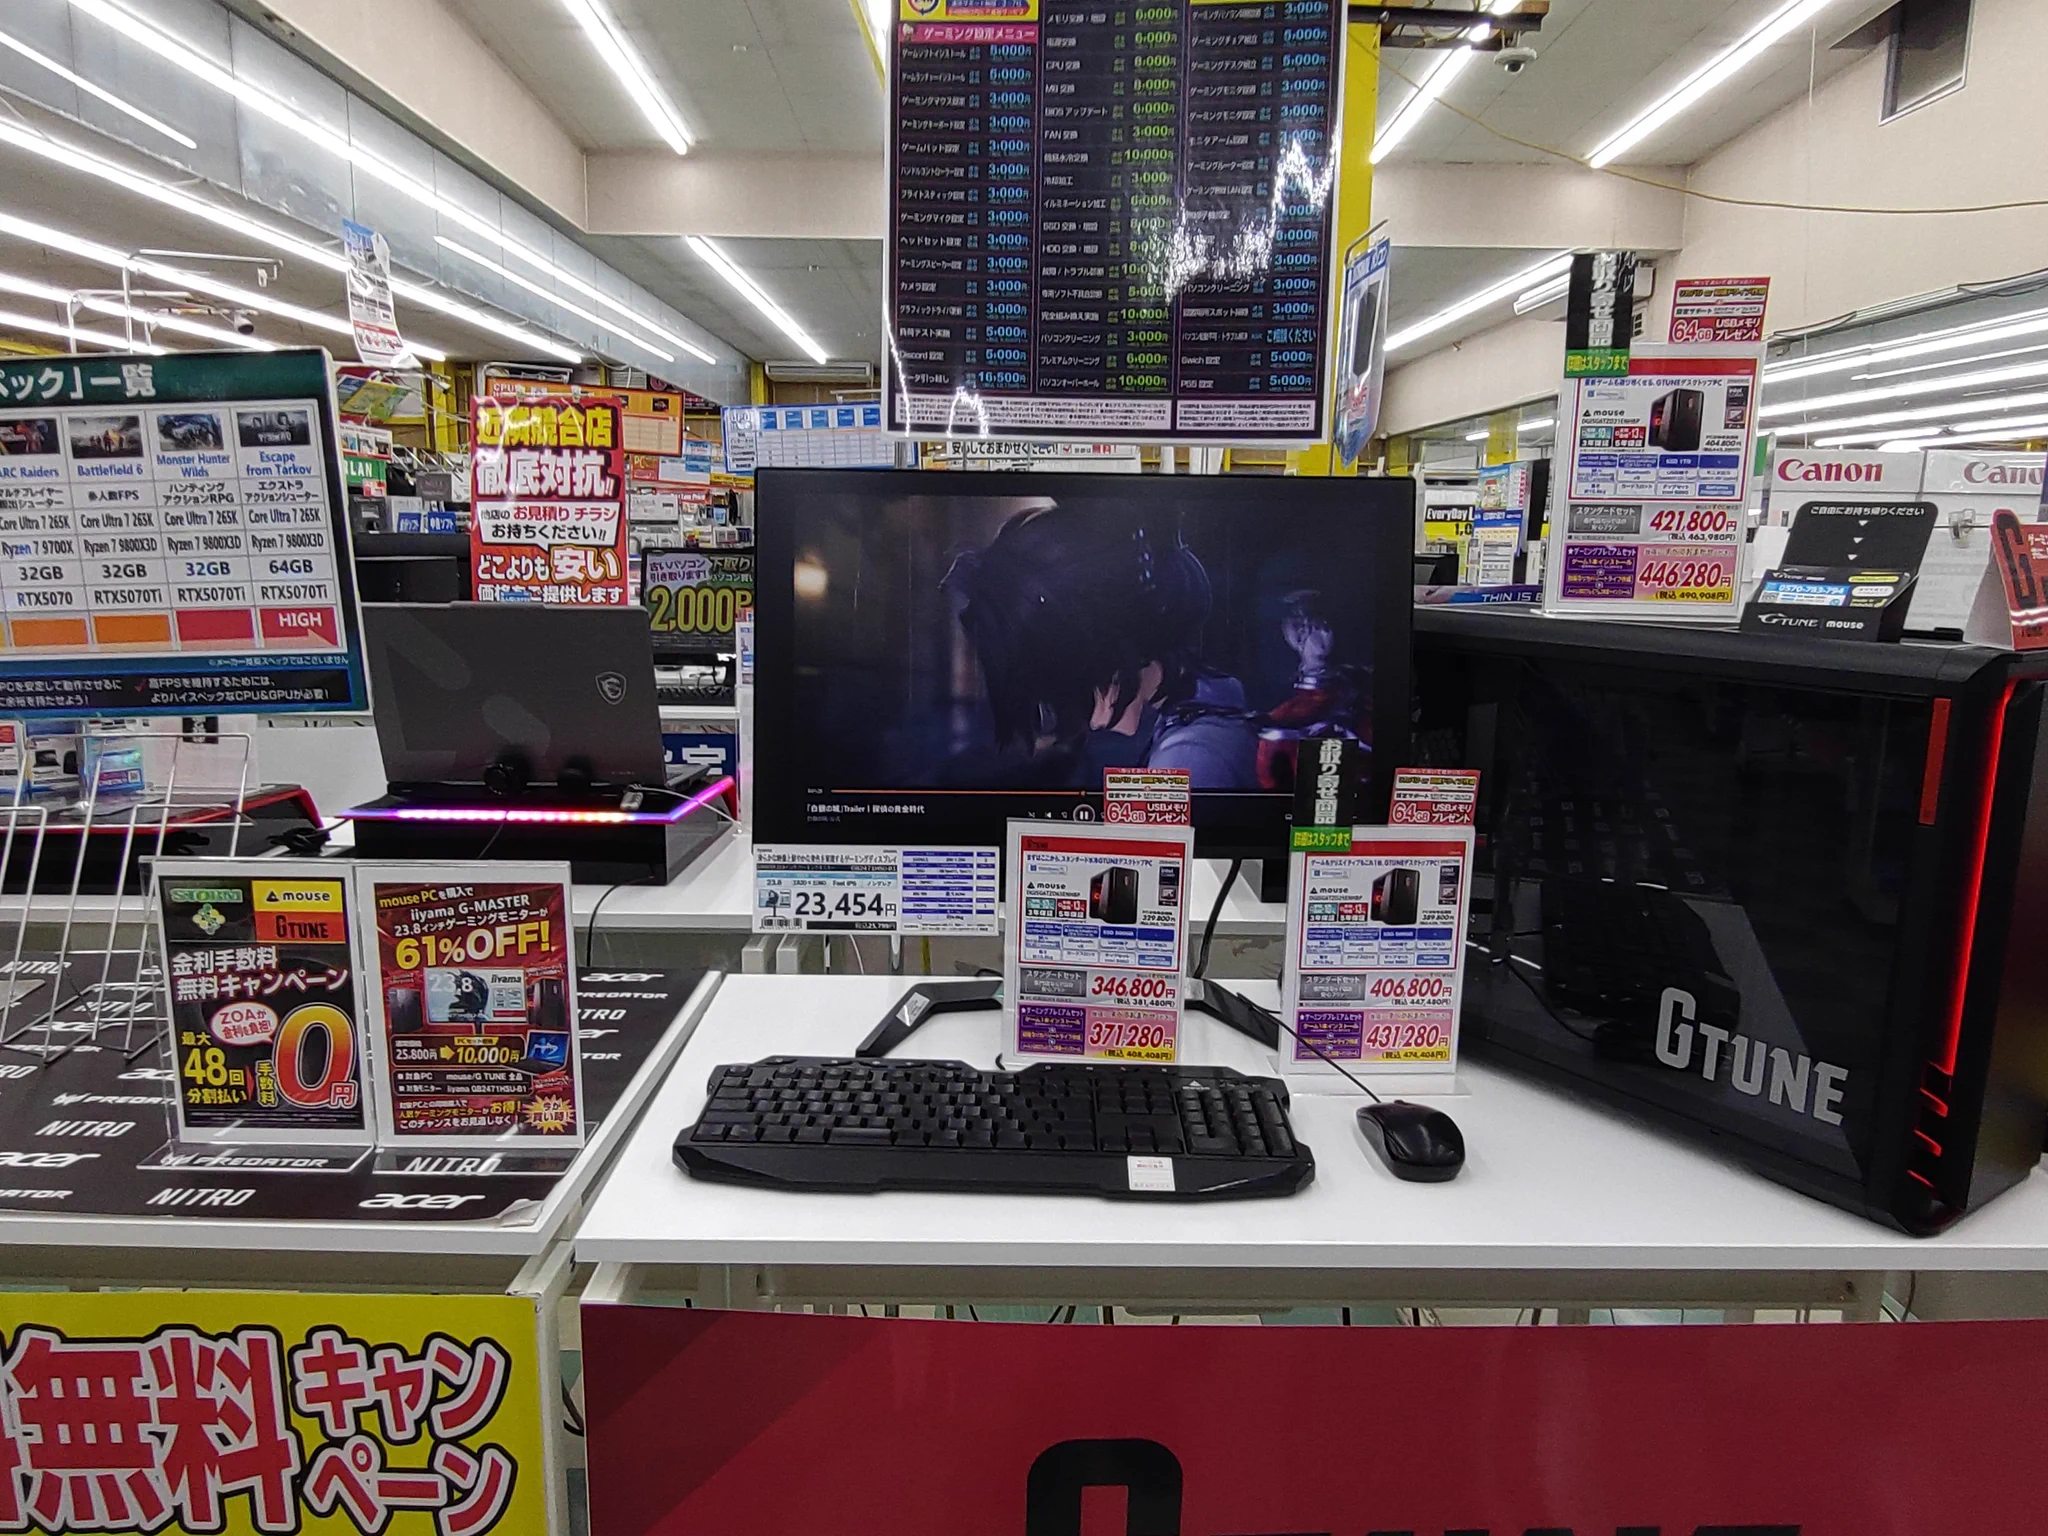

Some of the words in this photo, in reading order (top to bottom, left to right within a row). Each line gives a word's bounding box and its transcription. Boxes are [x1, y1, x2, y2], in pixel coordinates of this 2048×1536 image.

[924, 27, 1035, 40] ゲーミング設定メニュー
[1716, 318, 1761, 328] USBメモリ
[1672, 320, 1713, 342] 64GB
[1715, 329, 1759, 342] プレゼント
[478, 406, 612, 447] 近隣競合店
[157, 453, 195, 465] Monster
[198, 453, 231, 464] Hunter
[259, 451, 296, 464] Escape
[20, 464, 59, 478] Raiders
[77, 464, 133, 477] Battlefield
[135, 464, 143, 475] 6
[181, 465, 209, 478] Wilds
[246, 464, 274, 476] from
[275, 463, 312, 476] Tarkov
[1777, 458, 1883, 483] Canon
[1963, 461, 2044, 484] Cano
[169, 482, 225, 493] ハンティング
[258, 480, 304, 491] エクストラ
[162, 492, 235, 505] アクションRPG
[249, 509, 269, 524] Core
[271, 509, 292, 523] Ultra
[293, 509, 299, 523] 7
[300, 508, 321, 523] 265K
[513, 506, 569, 521] お見積り
[574, 507, 616, 521] チラシ
[1426, 508, 1468, 520] EveryDay
[1469, 509, 1475, 520] L
[1576, 507, 1636, 516] スタンダードセット
[1810, 505, 1925, 517] ご自由にお持ち帰りください
[1650, 510, 1737, 532] 421,800円
[2, 540, 32, 559] Ryzen
[33, 540, 40, 557] 7
[41, 539, 74, 556] 9700X
[84, 539, 109, 557] Ryzen
[111, 538, 117, 552] 7
[252, 536, 277, 553] Ryzen
[278, 535, 284, 549] 7
[186, 562, 231, 576] 32GB
[269, 559, 314, 574] 64GB
[477, 554, 549, 581] どこよりも
[552, 546, 622, 581] 安い
[650, 560, 706, 571] 古いパソコン
[19, 566, 64, 581] 32GB
[102, 564, 147, 579] 32GB
[650, 570, 707, 583] 引き取ります!
[1638, 562, 1731, 587] 446,280円
[17, 591, 73, 605] RTX5070
[95, 589, 162, 604] RTX5070Ti
[178, 587, 245, 602] RTX5070Ti
[261, 585, 328, 600] RTX5070Ti
[1482, 593, 1513, 602] THIN
[1517, 593, 1532, 602] IS
[279, 612, 323, 628] HIGH
[1757, 612, 1818, 627] GTUNE
[1826, 620, 1864, 629] mouse
[1314, 739, 1343, 825] お取り寄せ商品
[1107, 802, 1146, 823] 64GB
[1147, 803, 1188, 812] USBメモリ
[1392, 802, 1430, 823] 64GB
[1432, 804, 1472, 812] USBメモリ
[1147, 813, 1188, 823] プレゼント
[1432, 814, 1471, 823] プレゼント
[1037, 882, 1066, 890] mouse
[282, 890, 331, 901] mouse
[379, 895, 420, 908] mouse
[410, 907, 455, 922] iiyama
[458, 895, 530, 916] G-MASTER
[795, 892, 897, 919] 23,454円
[275, 914, 329, 940] GTUNE
[394, 908, 548, 937] 23.8インチゲーミングモニターが
[395, 920, 550, 970] 61%OFF!
[172, 946, 277, 977] 金利手数料
[491, 975, 522, 984] iiyama
[581, 973, 665, 982] acer
[1026, 971, 1081, 981] スタンダードセット
[1305, 976, 1361, 984] スタンダードセット
[176, 968, 348, 1001] 無料キャンペーン
[1091, 976, 1176, 999] 346,800円
[1370, 978, 1452, 998] 406,800円
[219, 1009, 267, 1025] ZOAが
[221, 1022, 272, 1040] 金利を負担!
[1089, 1022, 1173, 1049] 371,280円
[1366, 1024, 1448, 1048] 431,280円
[181, 1032, 211, 1046] 最大
[272, 1002, 358, 1109] 0円
[395, 1049, 437, 1061] 25,800円
[456, 1047, 520, 1064] 10,000円
[1656, 987, 1849, 1126] GTUNE
[184, 1047, 245, 1086] 48回
[256, 1060, 278, 1107] 手数料
[484, 1073, 507, 1081] TUNE
[187, 1087, 247, 1105] 分割払い
[490, 1100, 521, 1114] お得!
[34, 1120, 137, 1137] NITRO
[0, 1152, 102, 1168] acer
[192, 1156, 329, 1169] PREDATOR
[403, 1156, 503, 1174] NITRO
[146, 1188, 256, 1207] NITRO
[359, 1192, 487, 1210] acer
[300, 1335, 500, 1435] キャン
[0, 1329, 297, 1530] 無料
[306, 1440, 507, 1536] ペーン
